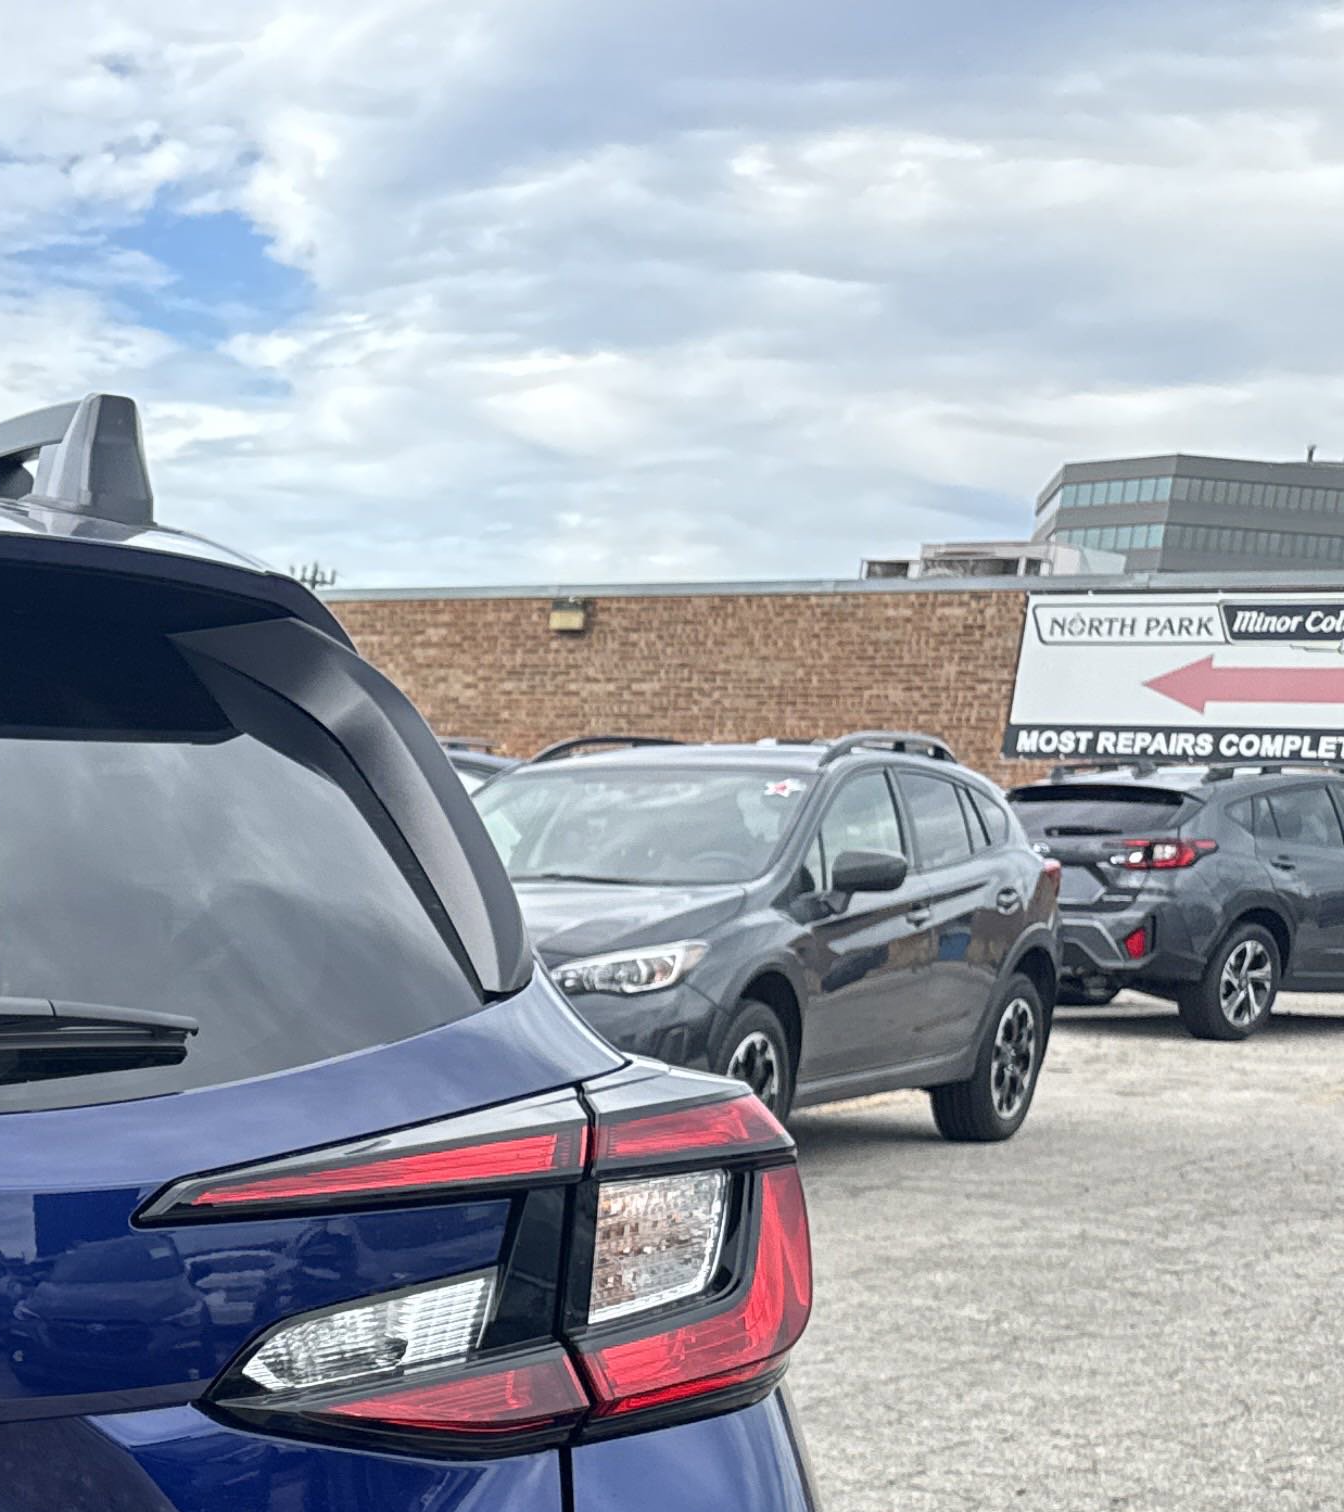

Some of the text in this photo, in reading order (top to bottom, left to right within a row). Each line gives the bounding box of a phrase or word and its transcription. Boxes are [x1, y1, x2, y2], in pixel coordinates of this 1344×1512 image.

[1049, 613, 1214, 637] NORTH PARK
[1232, 610, 1304, 633] Minor
[1016, 730, 1094, 754] MOST
[1096, 732, 1214, 757] REPAIRS
